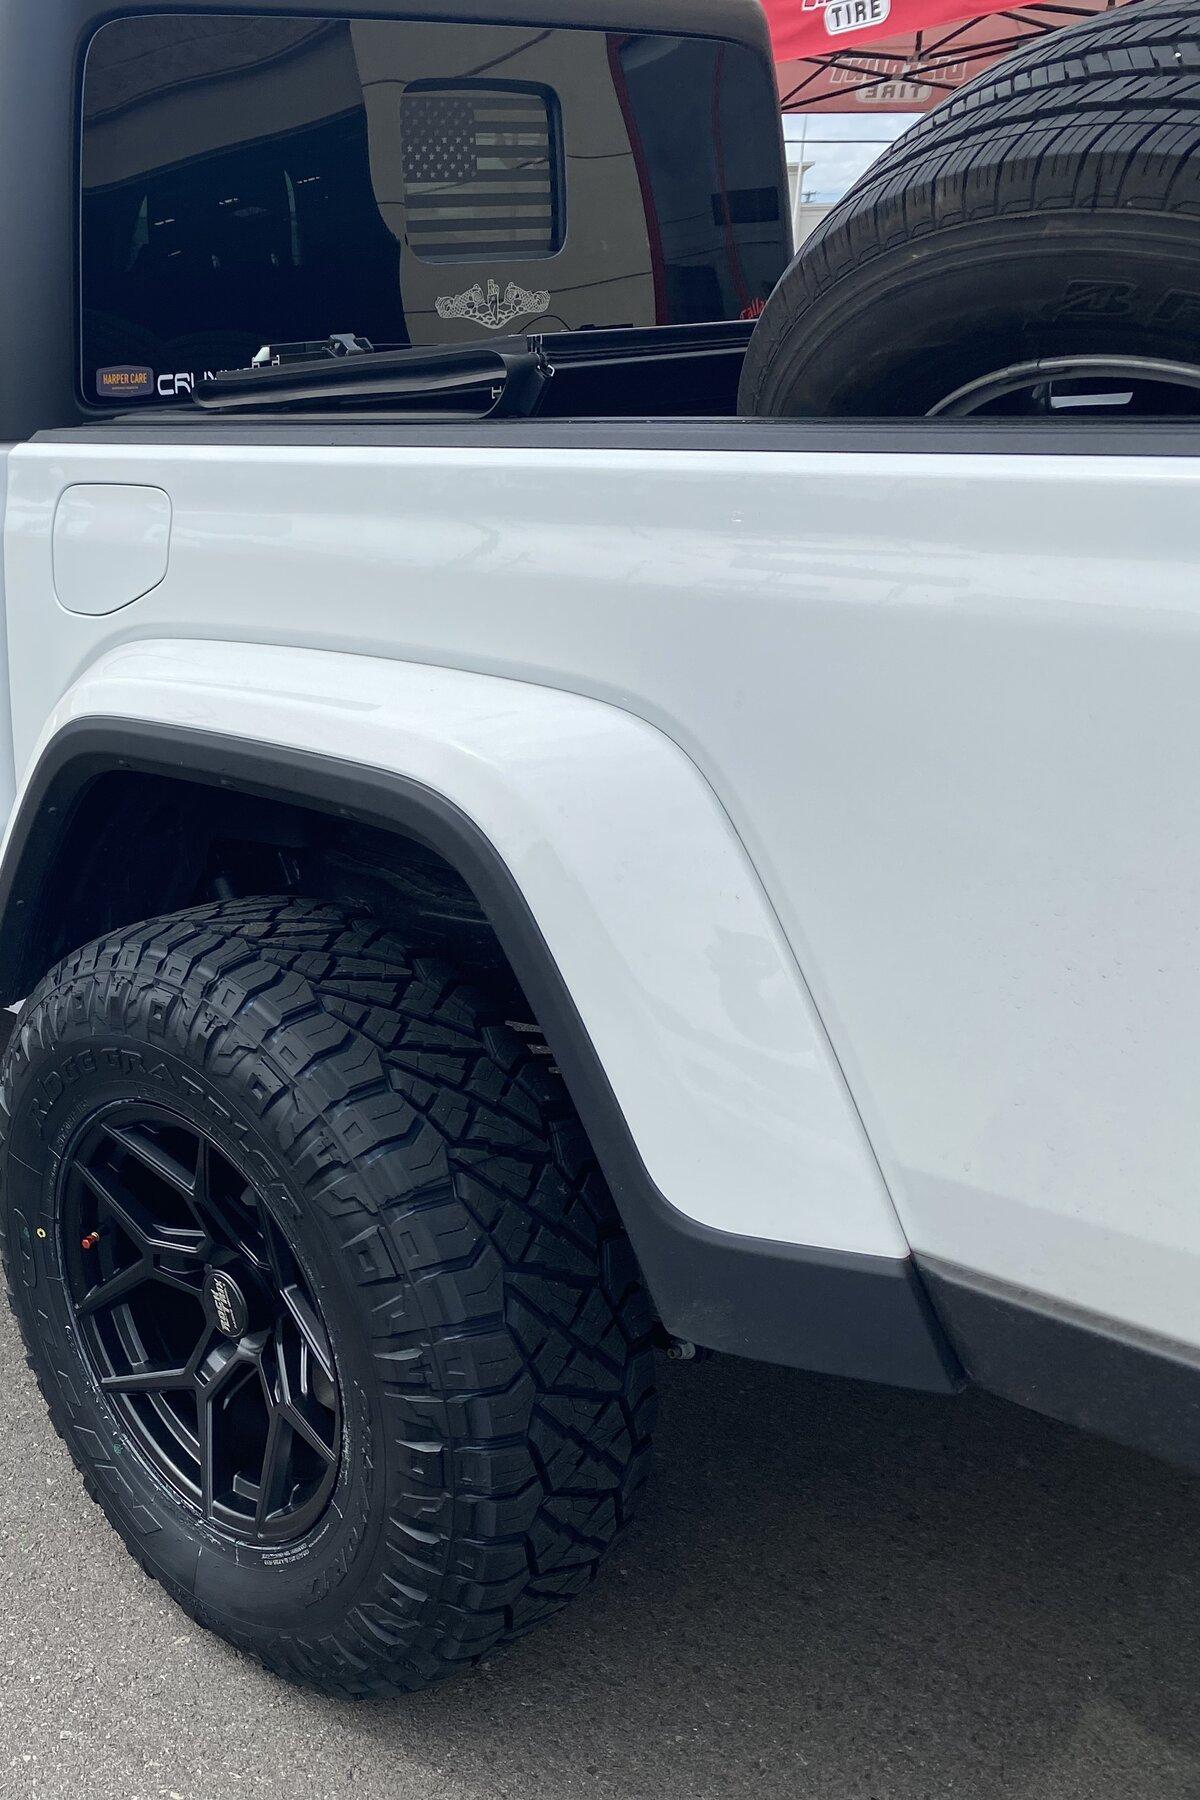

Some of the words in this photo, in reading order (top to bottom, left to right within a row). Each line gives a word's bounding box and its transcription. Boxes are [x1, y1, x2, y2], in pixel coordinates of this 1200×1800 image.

[831, 0, 882, 27] TIRE
[102, 373, 129, 385] HARPER
[130, 373, 148, 384] CARE
